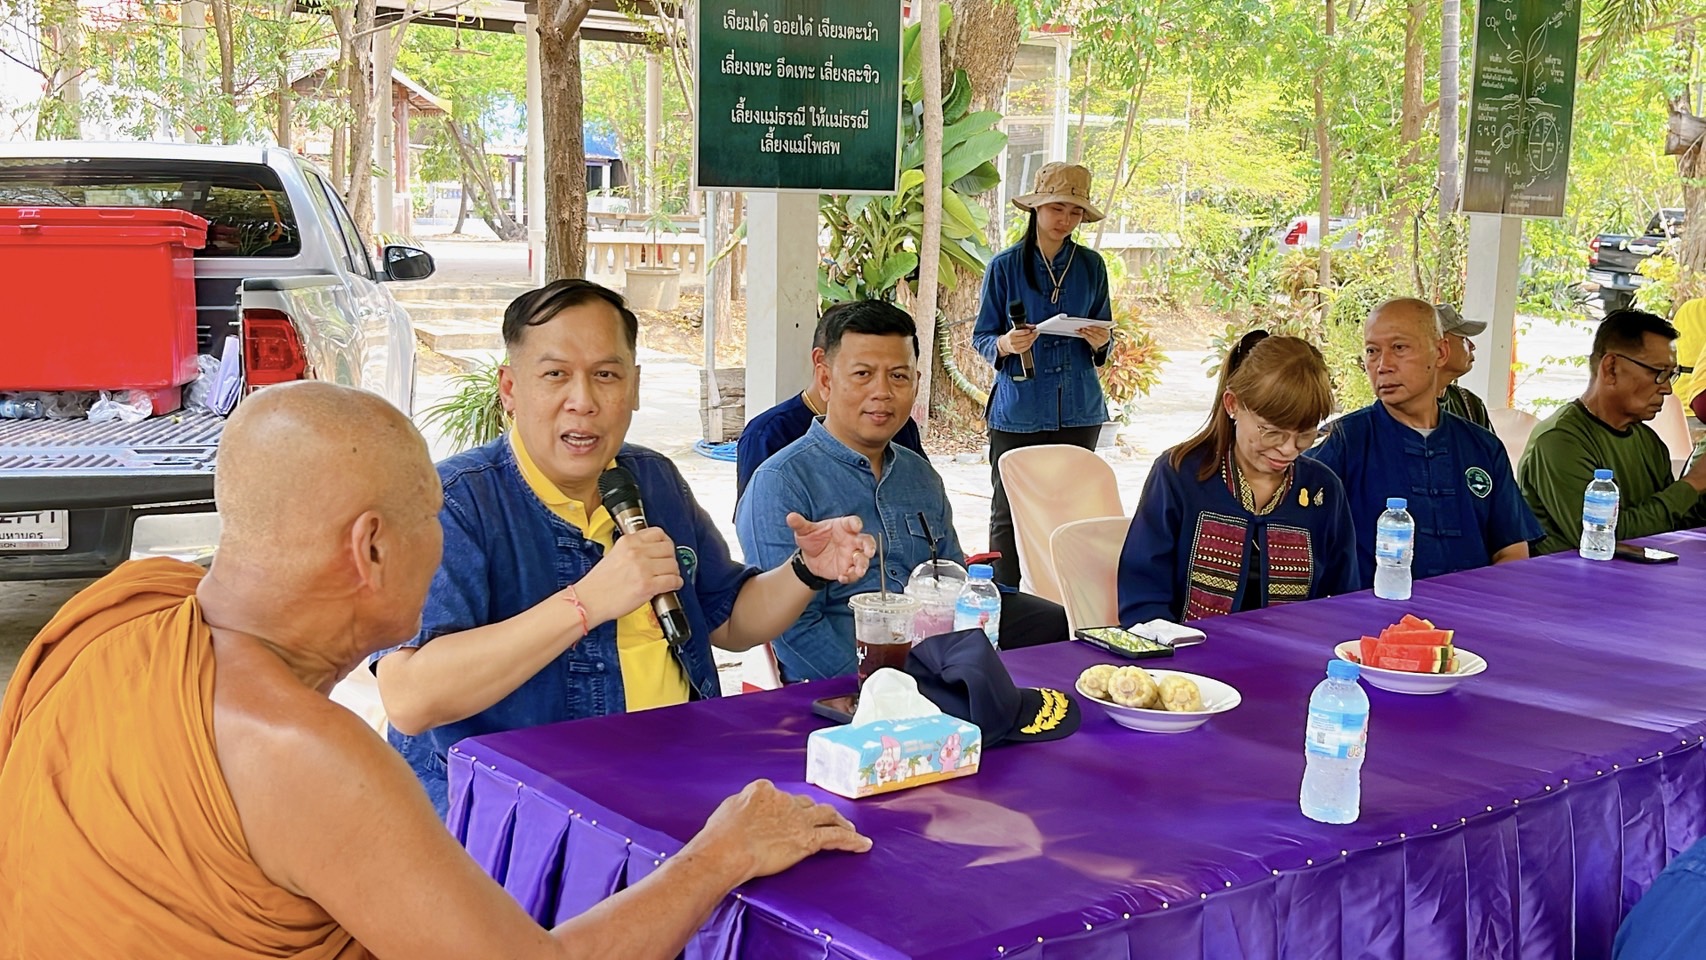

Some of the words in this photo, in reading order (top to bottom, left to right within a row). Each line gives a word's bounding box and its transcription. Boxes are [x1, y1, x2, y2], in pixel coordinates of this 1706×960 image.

[731, 96, 806, 126] เลี้ยงแม่ธรณี
[809, 106, 869, 129] ให้แม่ธรณี
[760, 126, 840, 155] เลี้ยงแม่โพสพ
